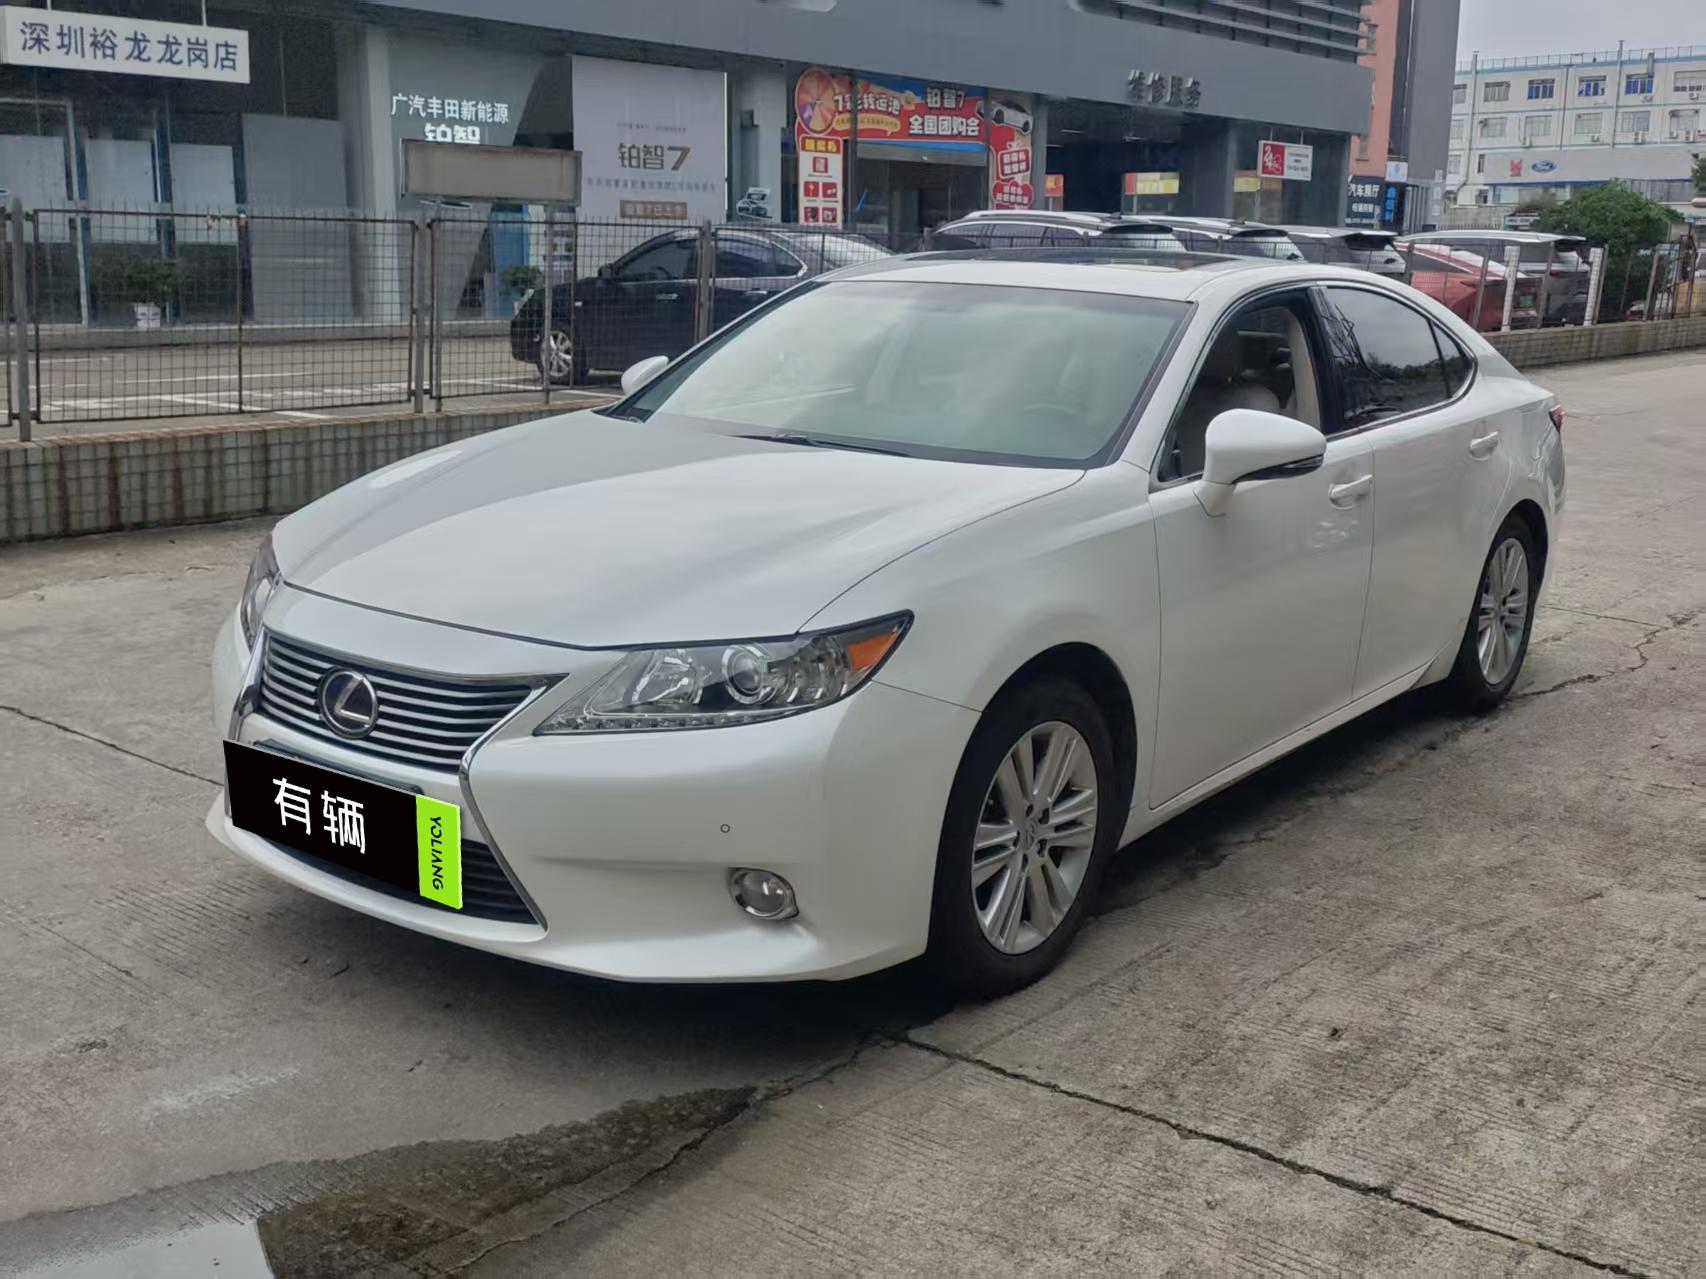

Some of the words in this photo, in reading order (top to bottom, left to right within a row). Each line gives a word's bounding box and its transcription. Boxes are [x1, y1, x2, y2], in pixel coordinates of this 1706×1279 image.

[20, 20, 239, 72] 深圳裕龙龙岗店
[390, 92, 510, 125] 广汽丰田新能源
[908, 114, 980, 137] 全国团购会
[618, 142, 692, 172] 铂智7
